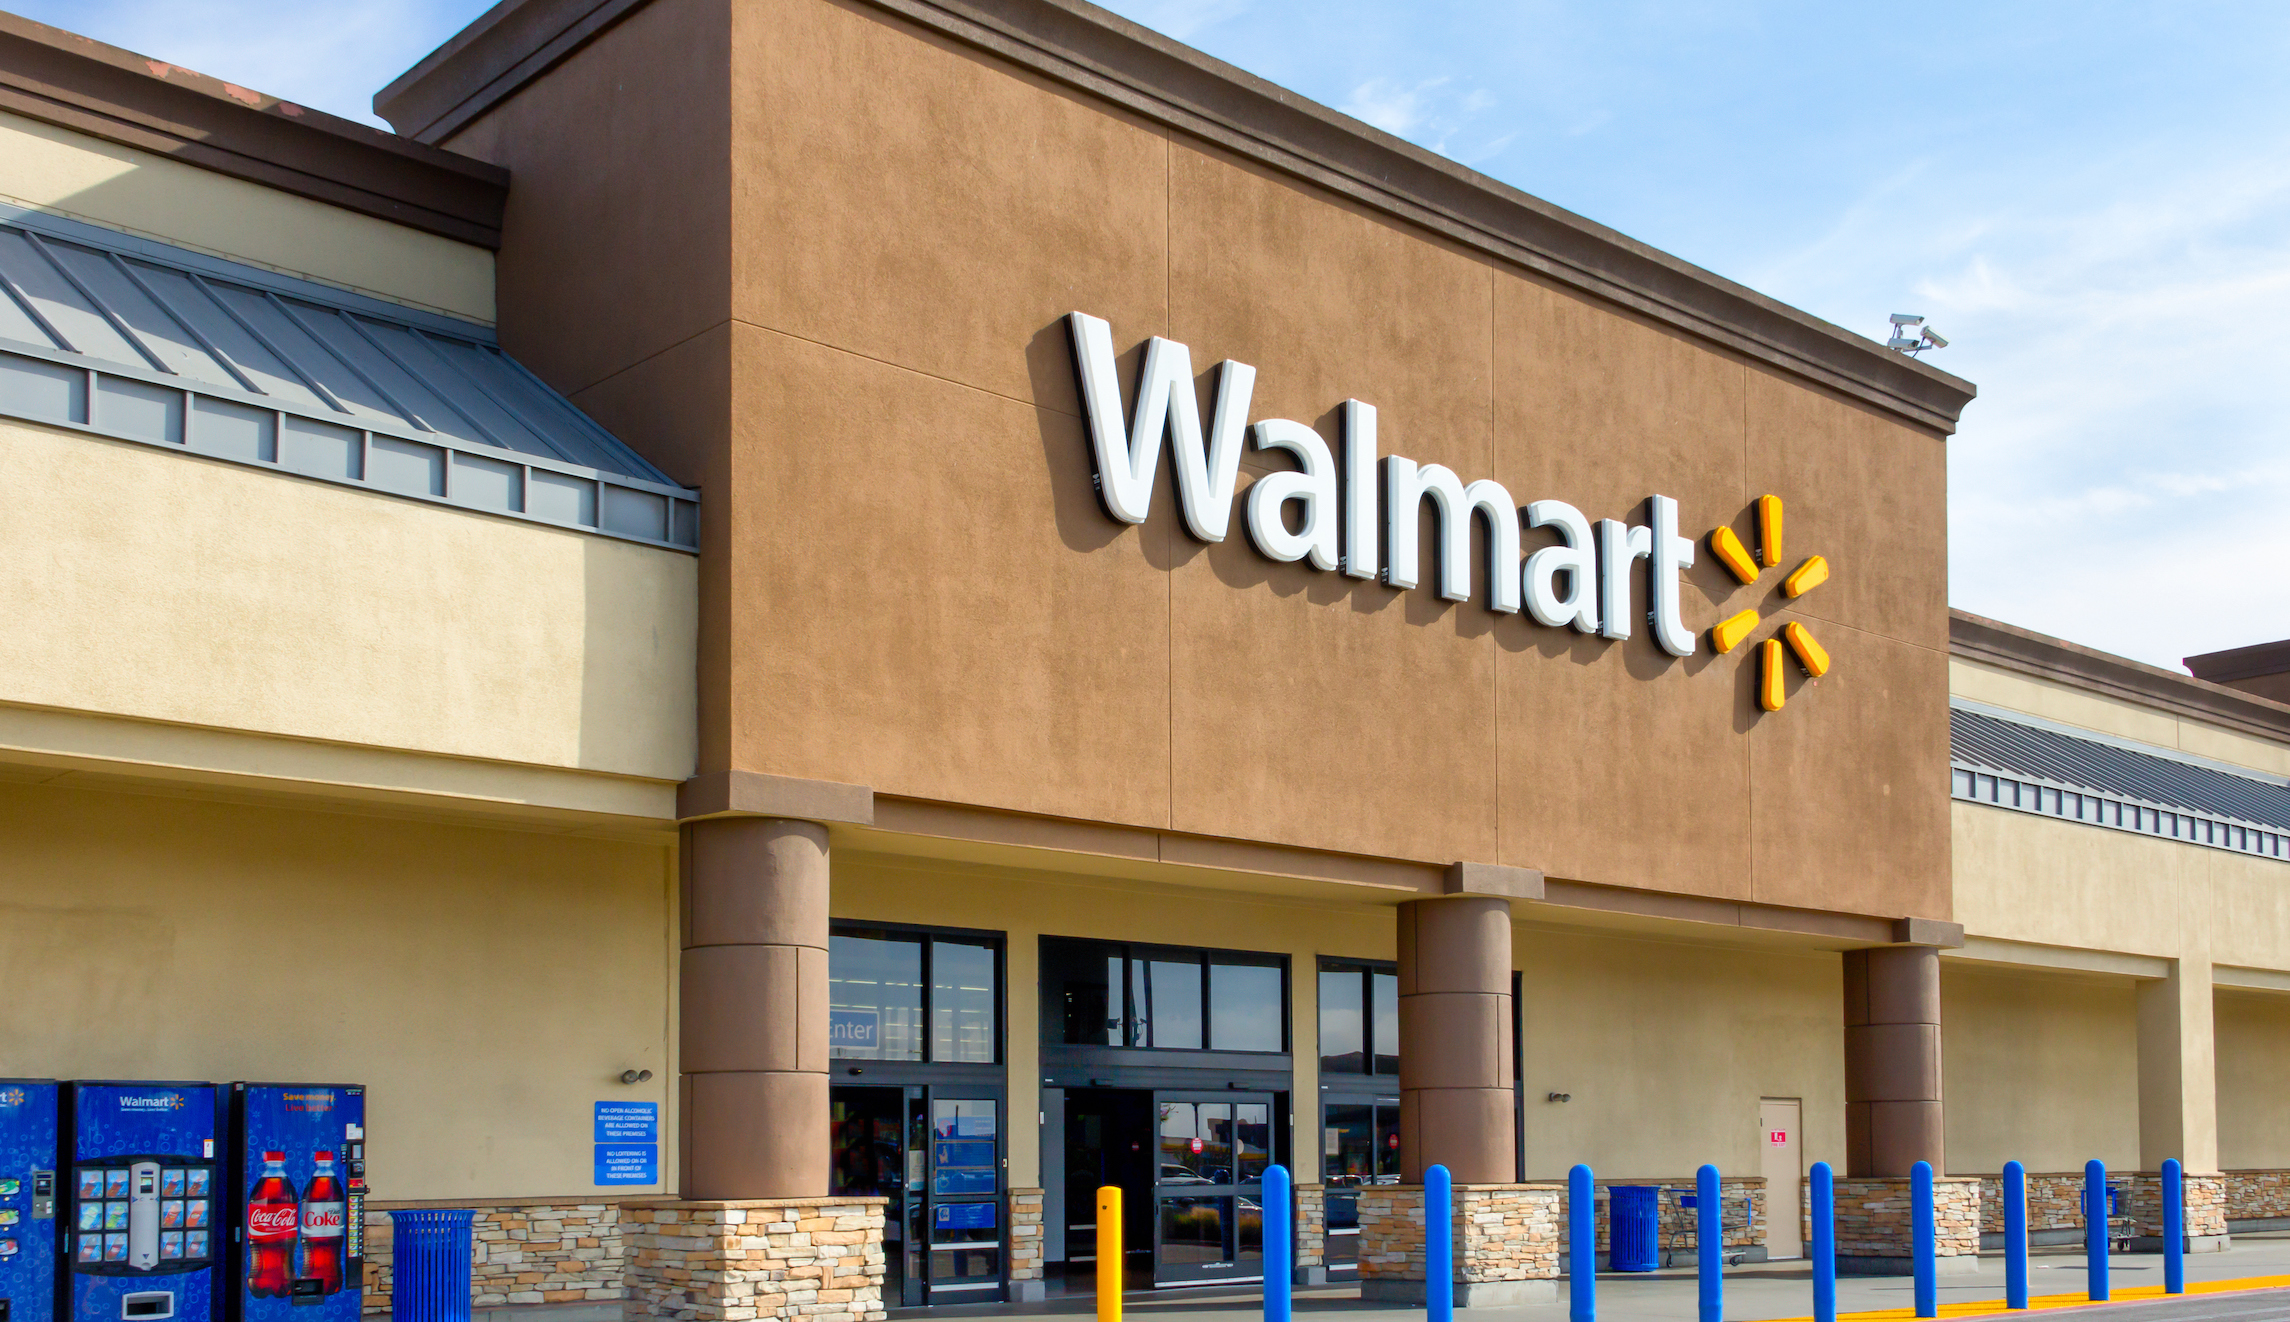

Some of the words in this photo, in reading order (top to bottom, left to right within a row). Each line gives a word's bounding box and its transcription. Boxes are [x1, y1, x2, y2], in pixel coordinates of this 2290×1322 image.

[1066, 310, 1696, 657] Walmart
[120, 1096, 169, 1107] Walmart
[283, 1093, 305, 1101] Save
[250, 1208, 297, 1227] Coca-Cola
[304, 1211, 340, 1227] Coke
